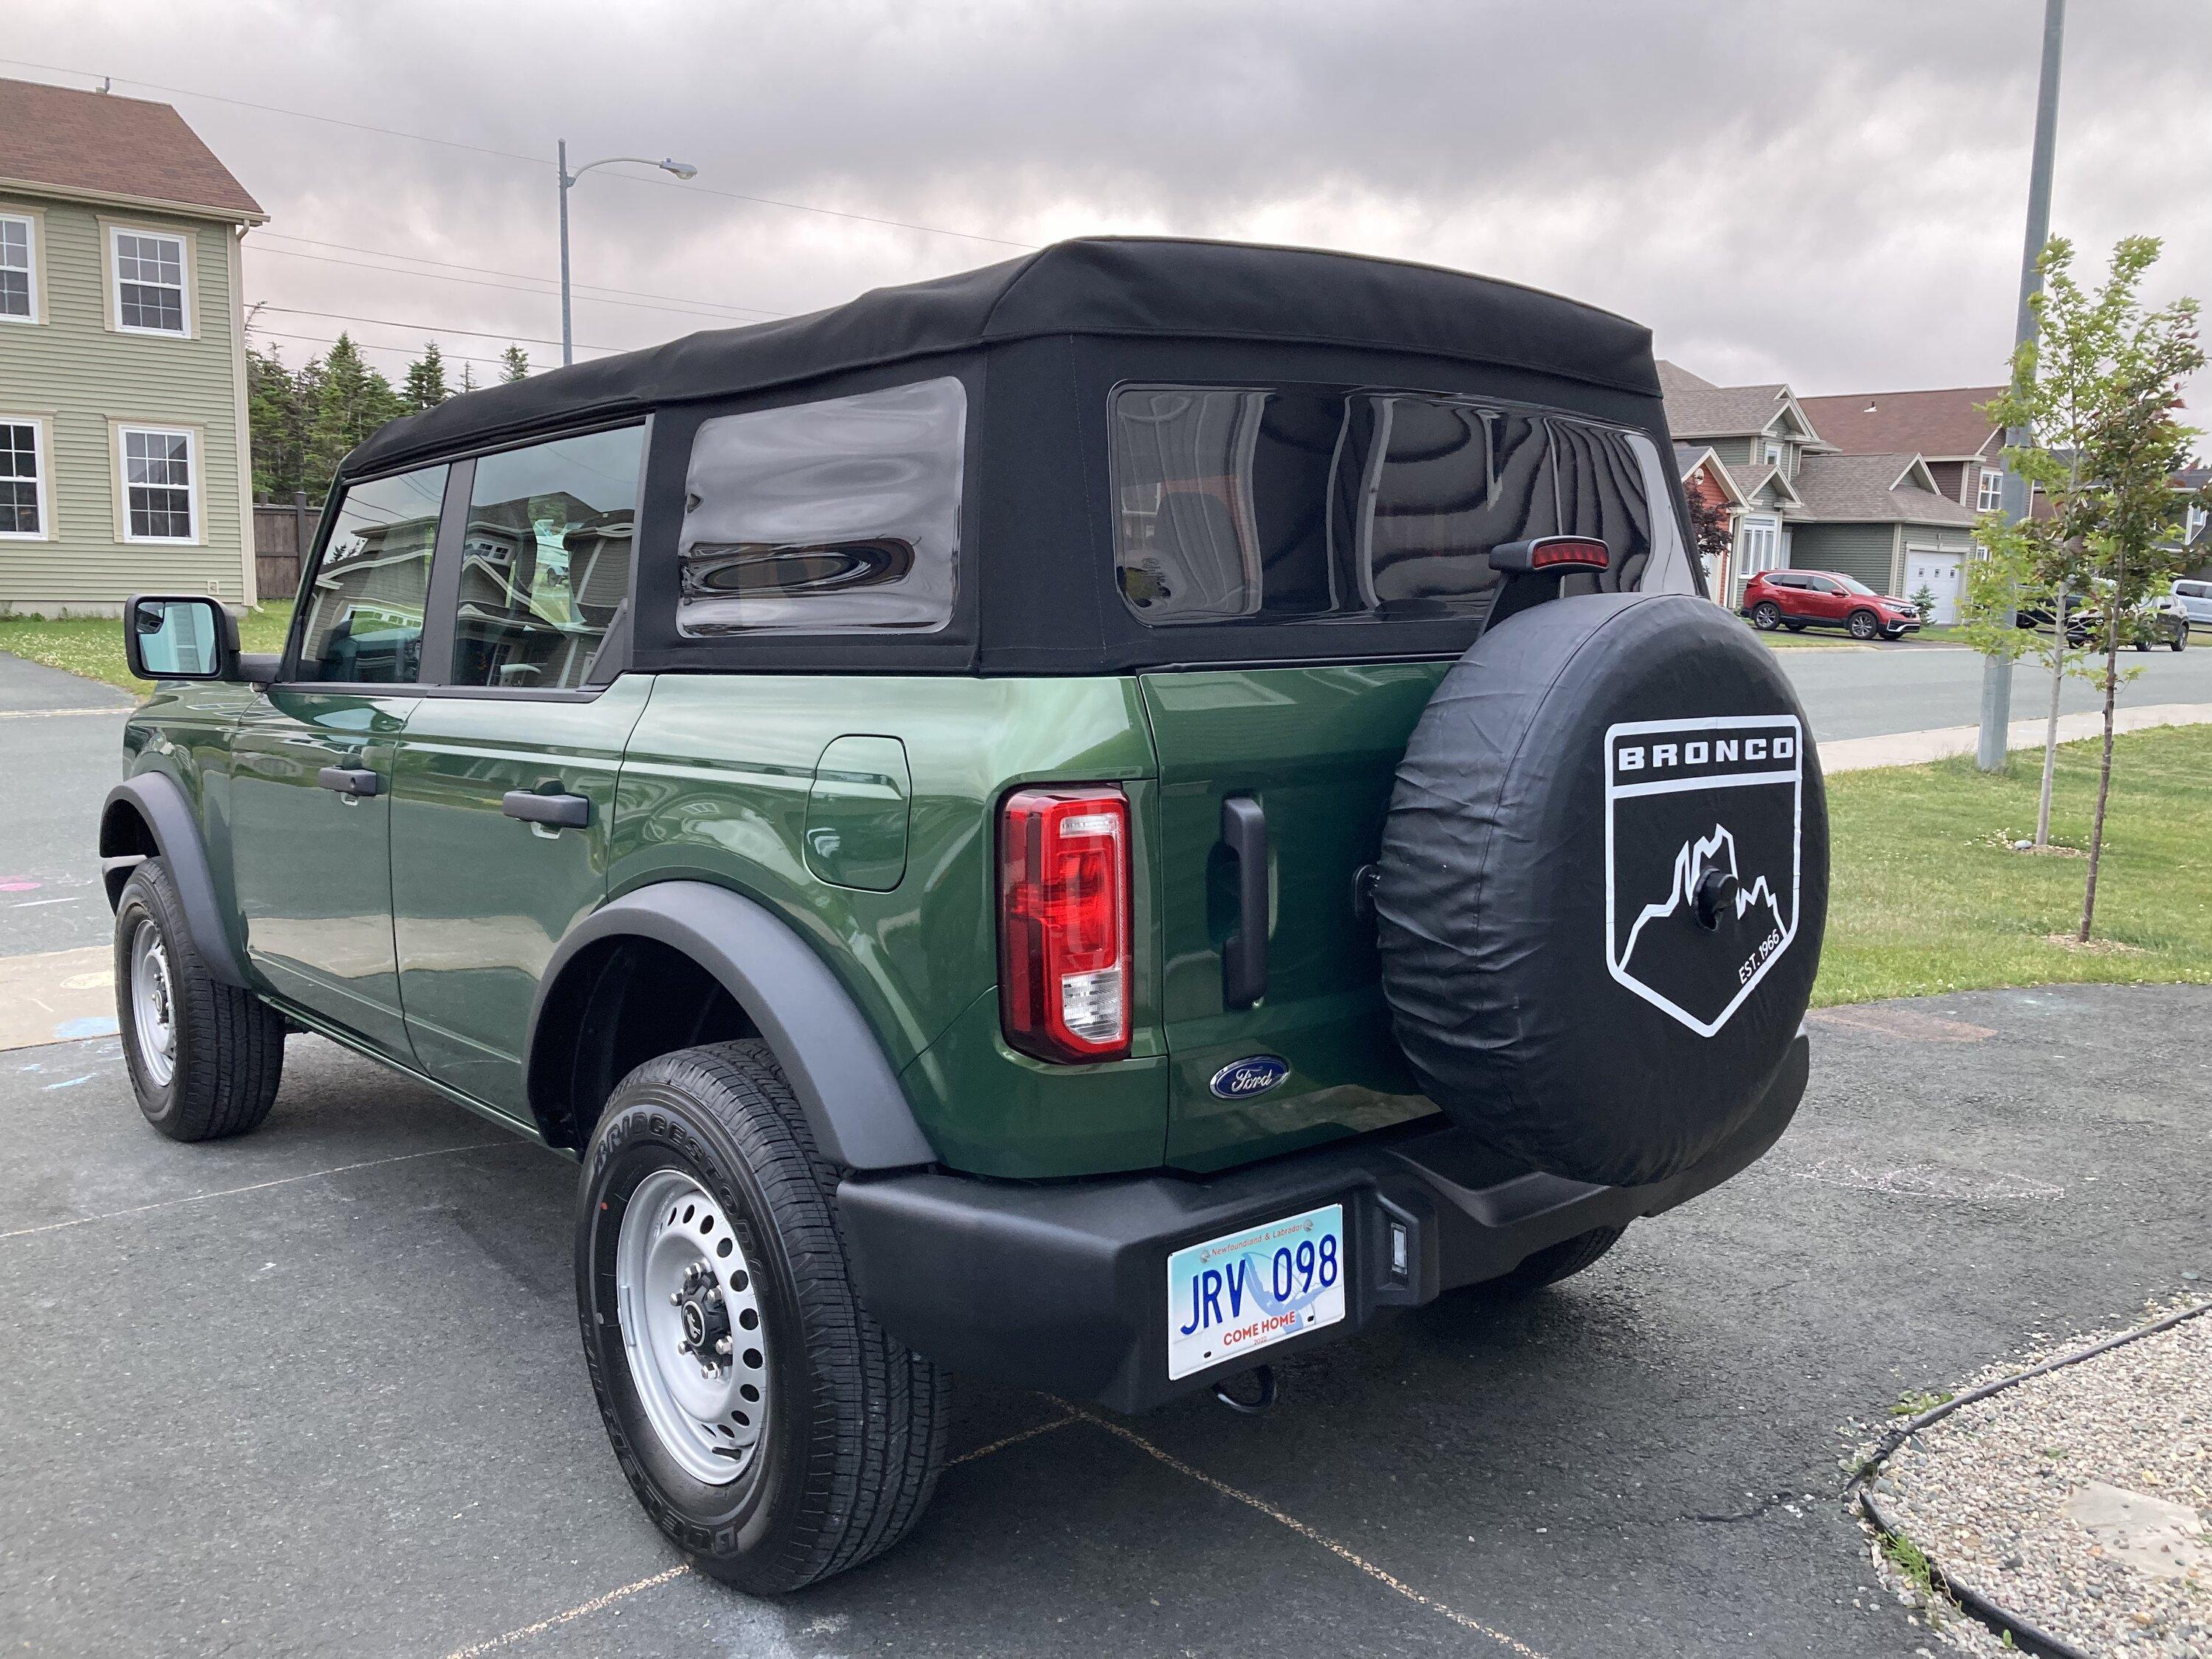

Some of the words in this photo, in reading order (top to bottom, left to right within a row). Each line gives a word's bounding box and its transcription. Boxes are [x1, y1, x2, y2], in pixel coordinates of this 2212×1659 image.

[1618, 737, 1794, 771] BRONCO
[1739, 953, 1761, 985] EST.
[1759, 928, 1780, 961] 1966
[1231, 1066, 1273, 1092] Ford
[594, 1111, 765, 1292] BRIDGESTONE
[1211, 1235, 1262, 1256] Newfoundland
[1265, 1232, 1270, 1240] &
[1273, 1223, 1303, 1238] Labrador
[1180, 1259, 1246, 1335] JRV
[1273, 1234, 1338, 1302] 098
[1223, 1323, 1259, 1346] COME
[1262, 1311, 1295, 1334] HOME
[1253, 1335, 1267, 1346] 2022
